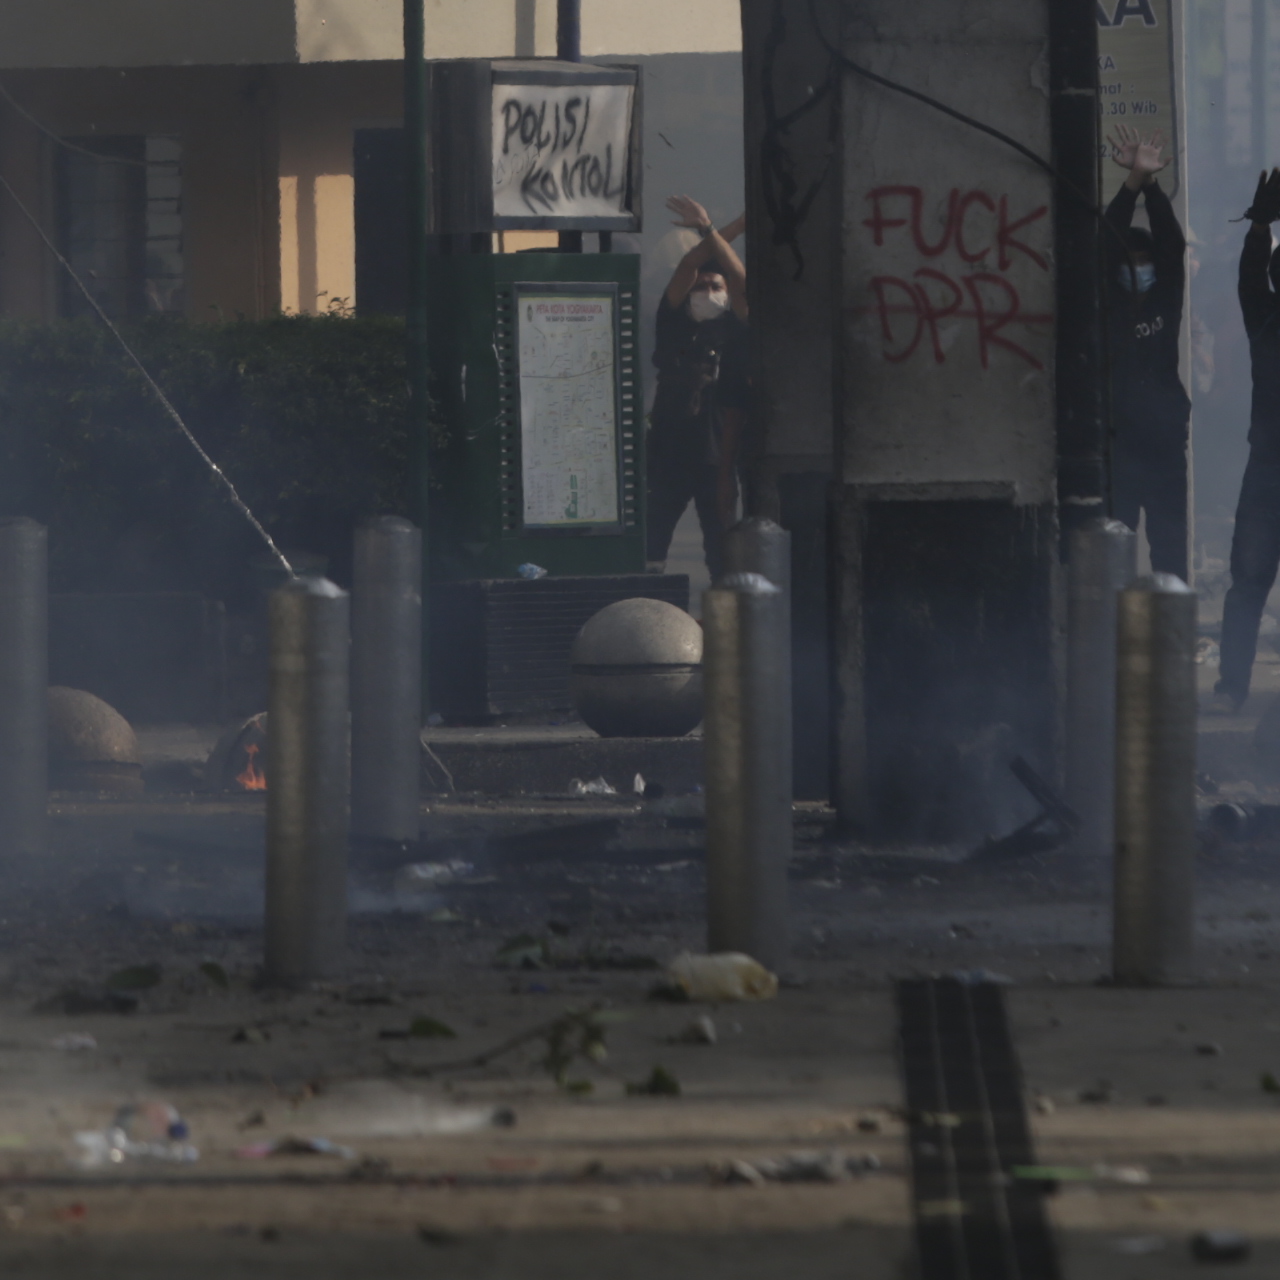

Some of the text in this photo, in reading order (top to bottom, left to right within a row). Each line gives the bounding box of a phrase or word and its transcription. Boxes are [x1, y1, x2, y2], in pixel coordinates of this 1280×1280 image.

[502, 95, 590, 155] POLISI
[1131, 100, 1157, 114] Wib
[520, 142, 624, 214] KONTOL
[862, 185, 1049, 272] FUCK
[867, 267, 1044, 370] DPR
